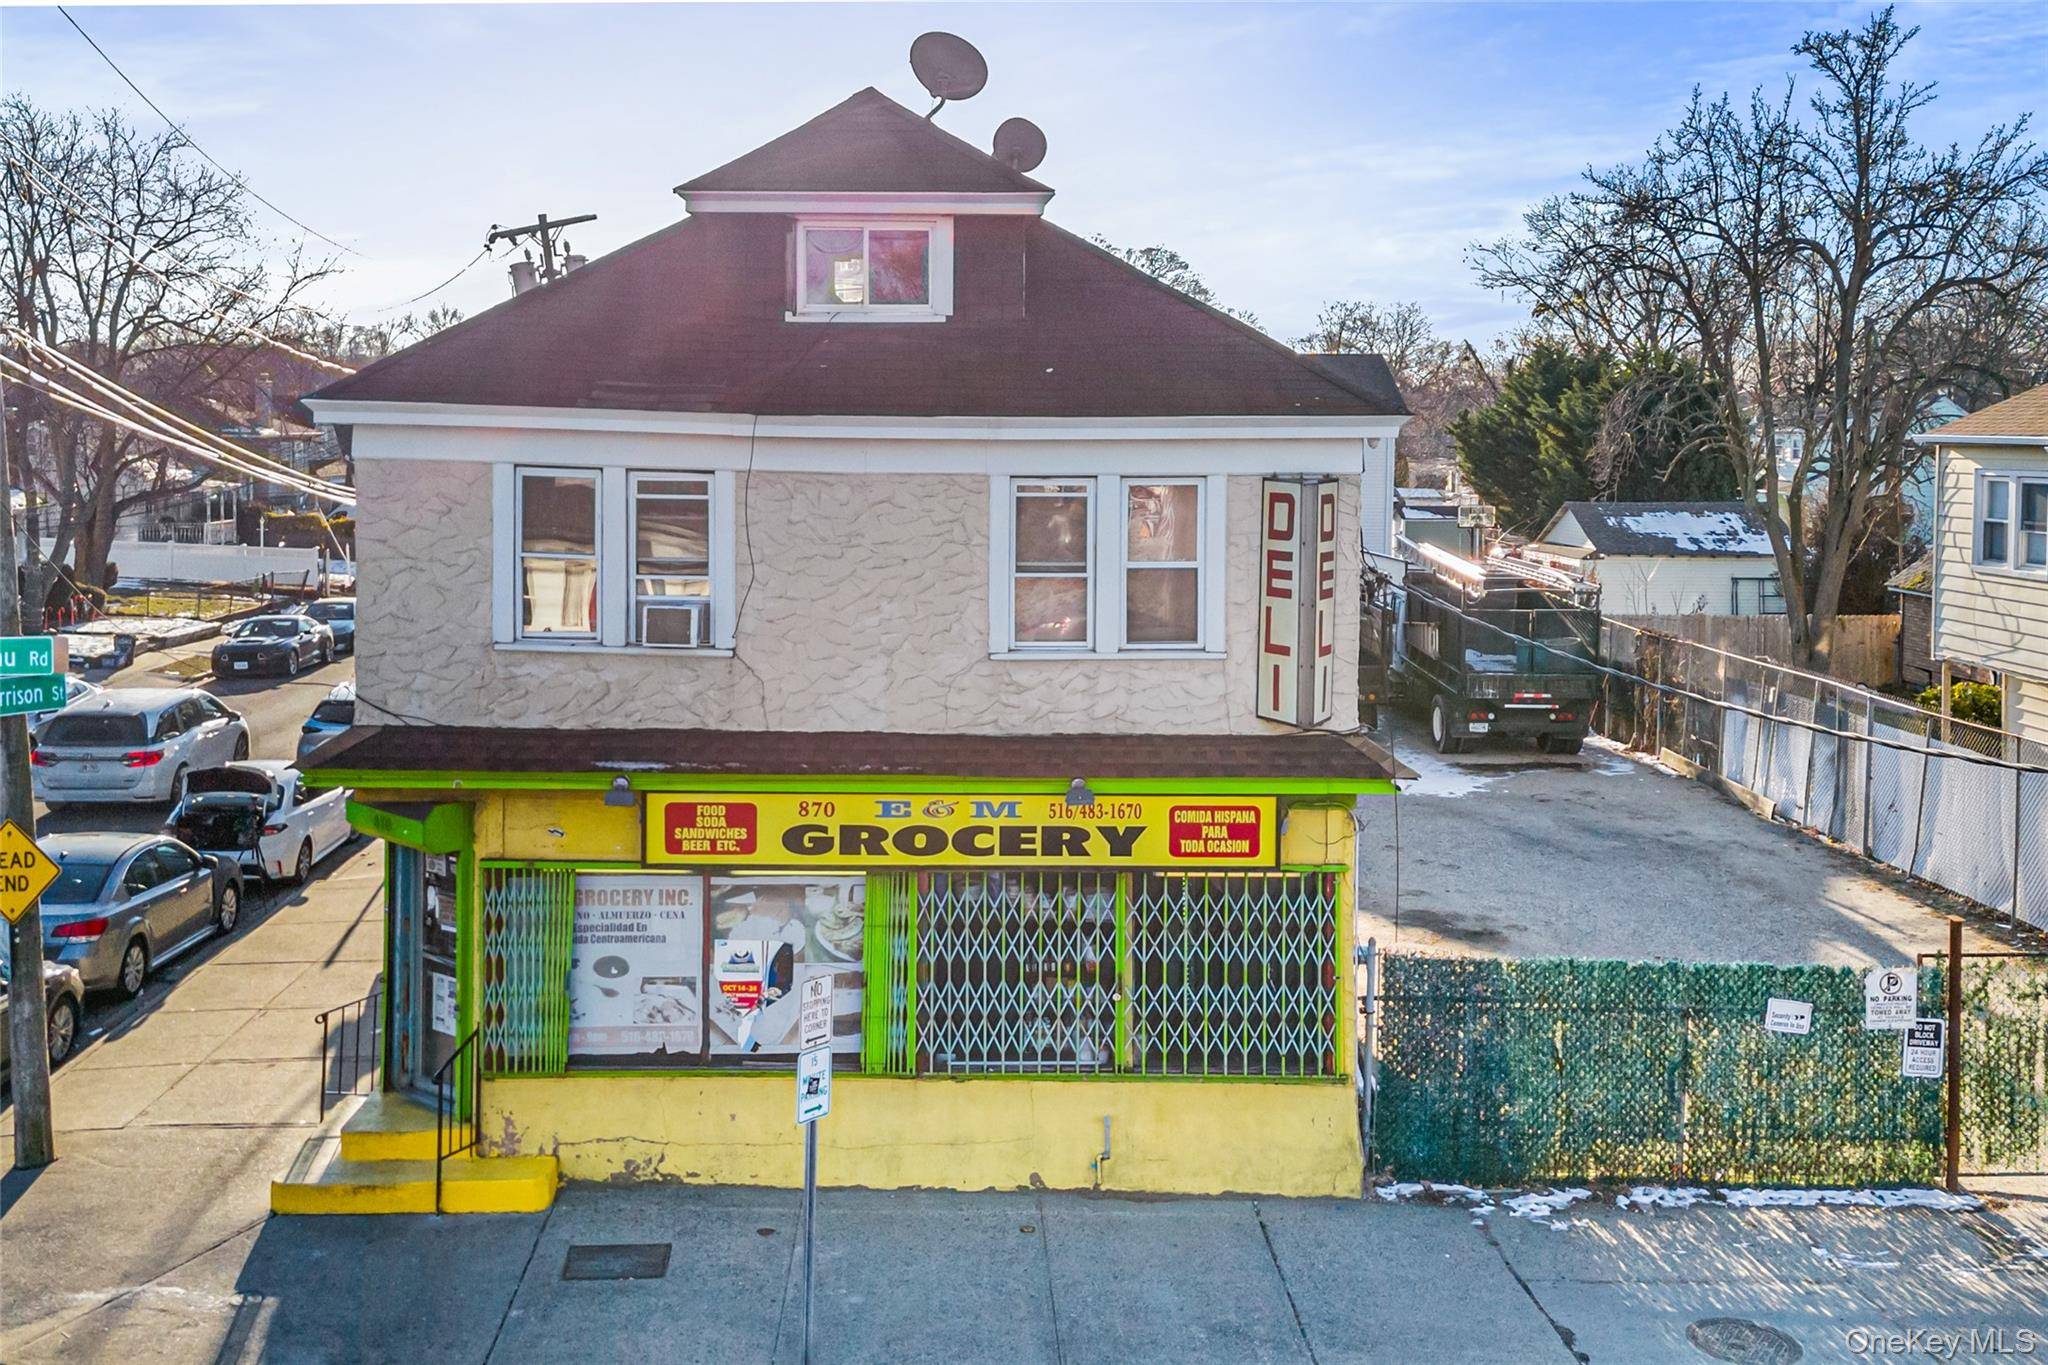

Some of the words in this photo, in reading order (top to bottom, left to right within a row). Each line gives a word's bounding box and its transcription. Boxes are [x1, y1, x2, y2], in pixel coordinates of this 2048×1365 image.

[1264, 492, 1295, 712] DELI
[1318, 493, 1335, 713] DELI
[0, 651, 16, 667] u
[29, 650, 48, 666] Rd
[52, 686, 64, 700] St
[696, 805, 726, 816] FOOD
[798, 801, 835, 817] 870
[875, 800, 911, 818] E
[922, 800, 960, 818] &
[970, 801, 1022, 818] M
[1048, 803, 1142, 820] 516/483-1670
[696, 816, 727, 827] SODA
[1174, 810, 1212, 823] COMIDA
[1214, 810, 1256, 824] HISPANA
[674, 828, 748, 839] SANDWICHES
[1202, 825, 1228, 838] PARA
[682, 840, 711, 851] BEER
[716, 840, 740, 851] ETC.
[781, 824, 1148, 857] GROCERY
[1180, 839, 1205, 853] TODA
[1207, 840, 1249, 853] OCASION
[575, 888, 654, 906] GROCERY
[658, 888, 693, 906] INC.
[600, 911, 651, 920] ALMUERZO
[659, 911, 685, 920] CENA
[636, 922, 647, 932] En
[590, 934, 666, 944] Centroamericana
[722, 984, 736, 992] OCT
[811, 981, 823, 998] NO
[1914, 1031, 1935, 1039] BLOCK
